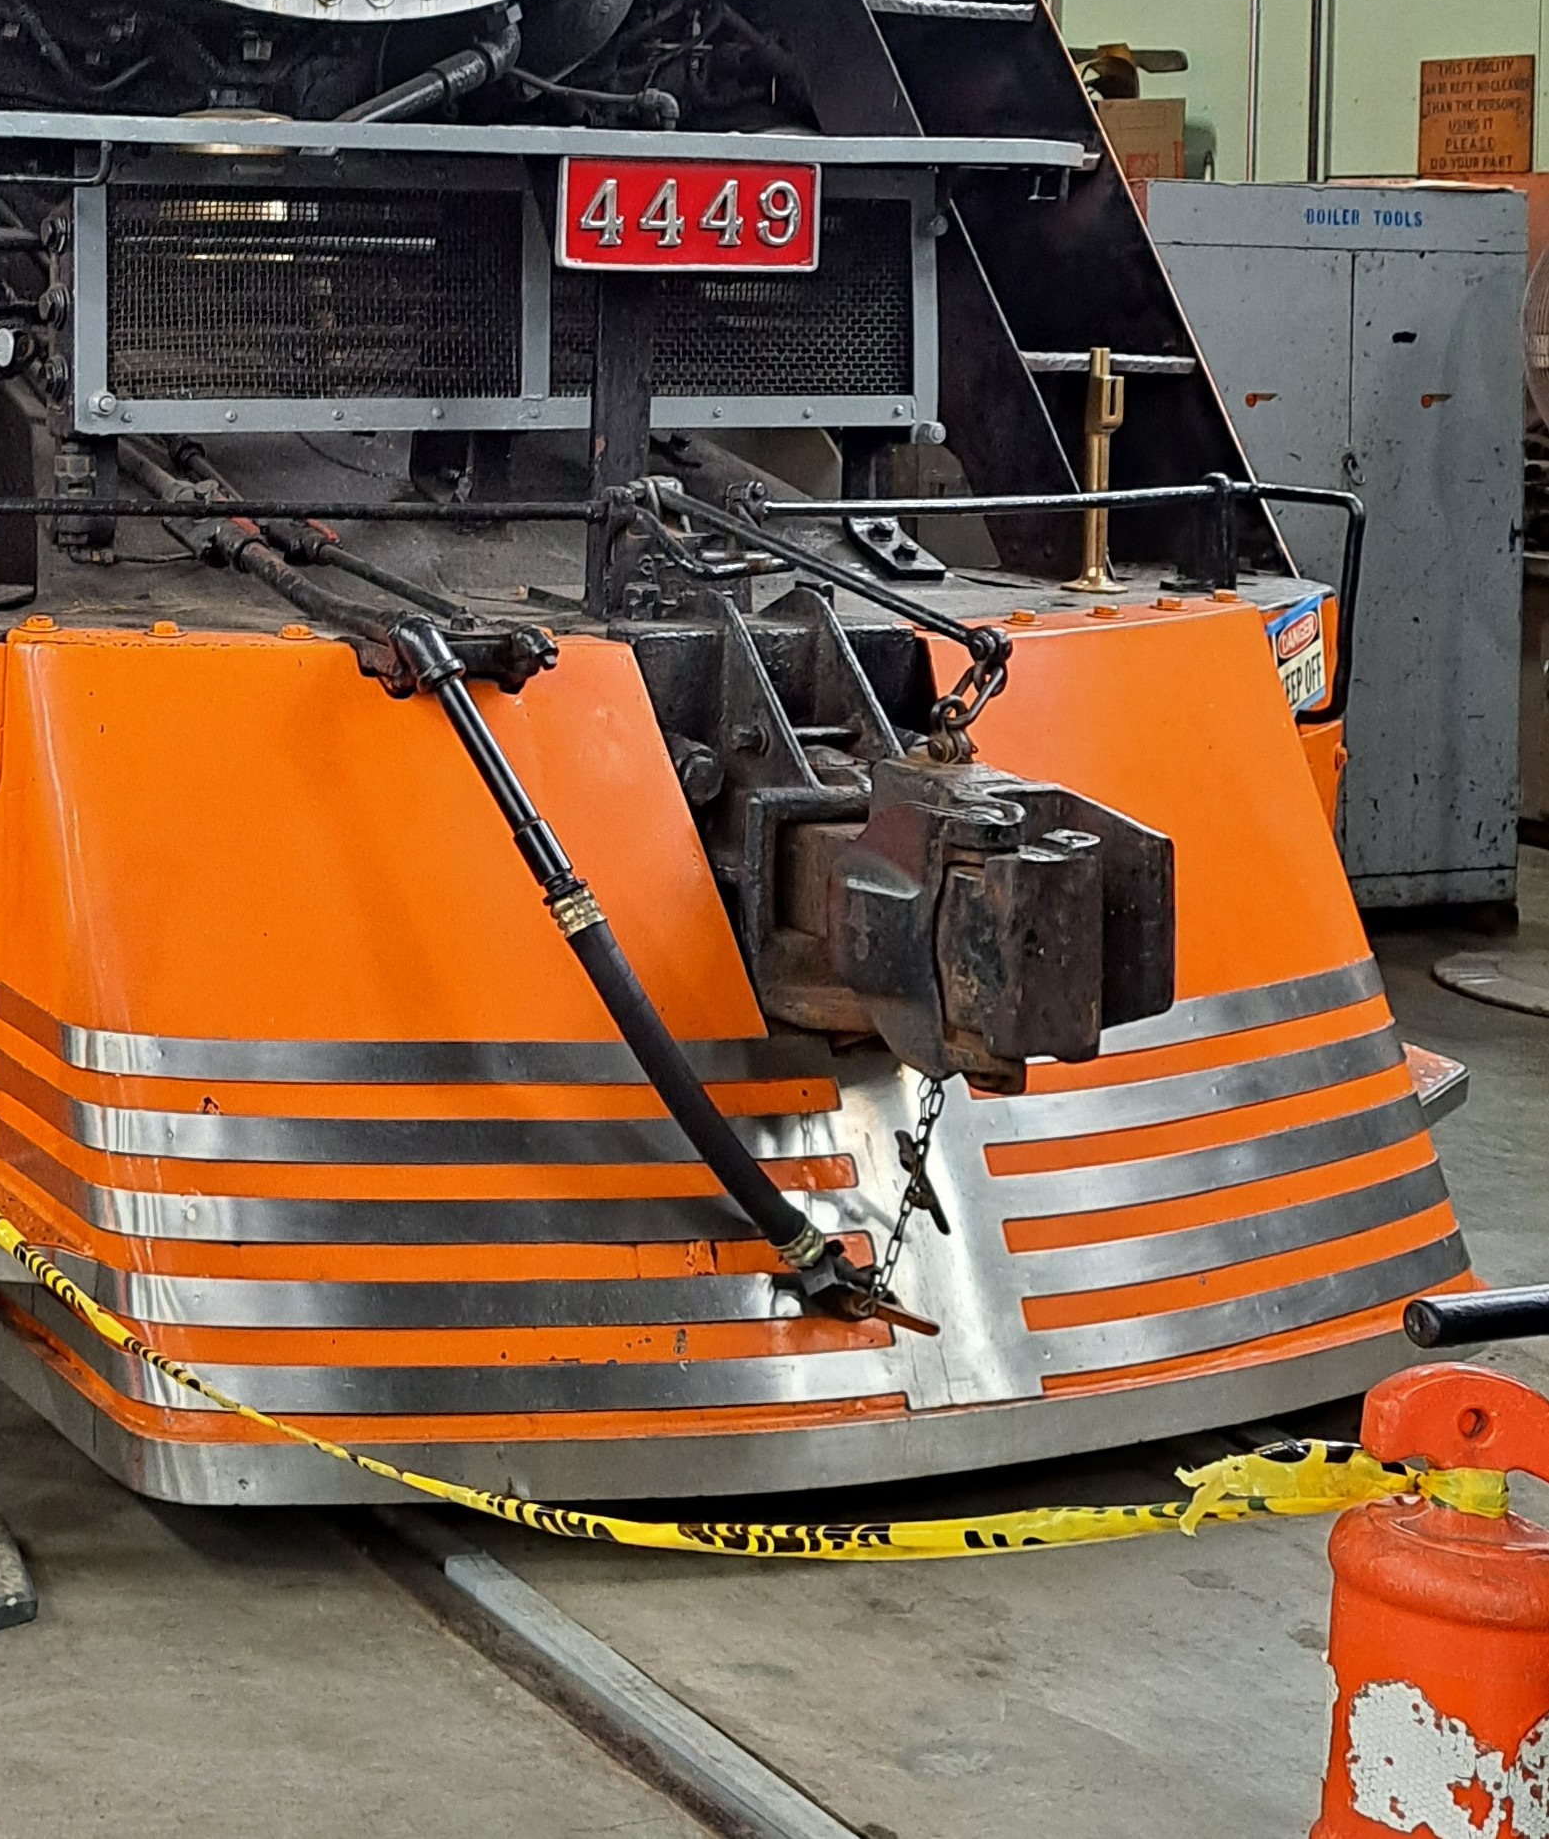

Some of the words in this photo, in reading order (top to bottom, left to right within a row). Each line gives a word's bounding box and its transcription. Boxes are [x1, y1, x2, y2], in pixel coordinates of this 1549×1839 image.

[1455, 99, 1474, 112] THE
[1483, 117, 1494, 129] IT
[1445, 136, 1495, 151] PLEASE
[1430, 157, 1447, 169] DO
[1452, 156, 1480, 169] YOUR
[1482, 155, 1512, 168] PART
[580, 178, 802, 246] 4449
[1306, 208, 1360, 226] BOILER
[1373, 210, 1423, 228] TOOLS
[1282, 666, 1303, 705] EEP
[1305, 650, 1322, 695] OFF
